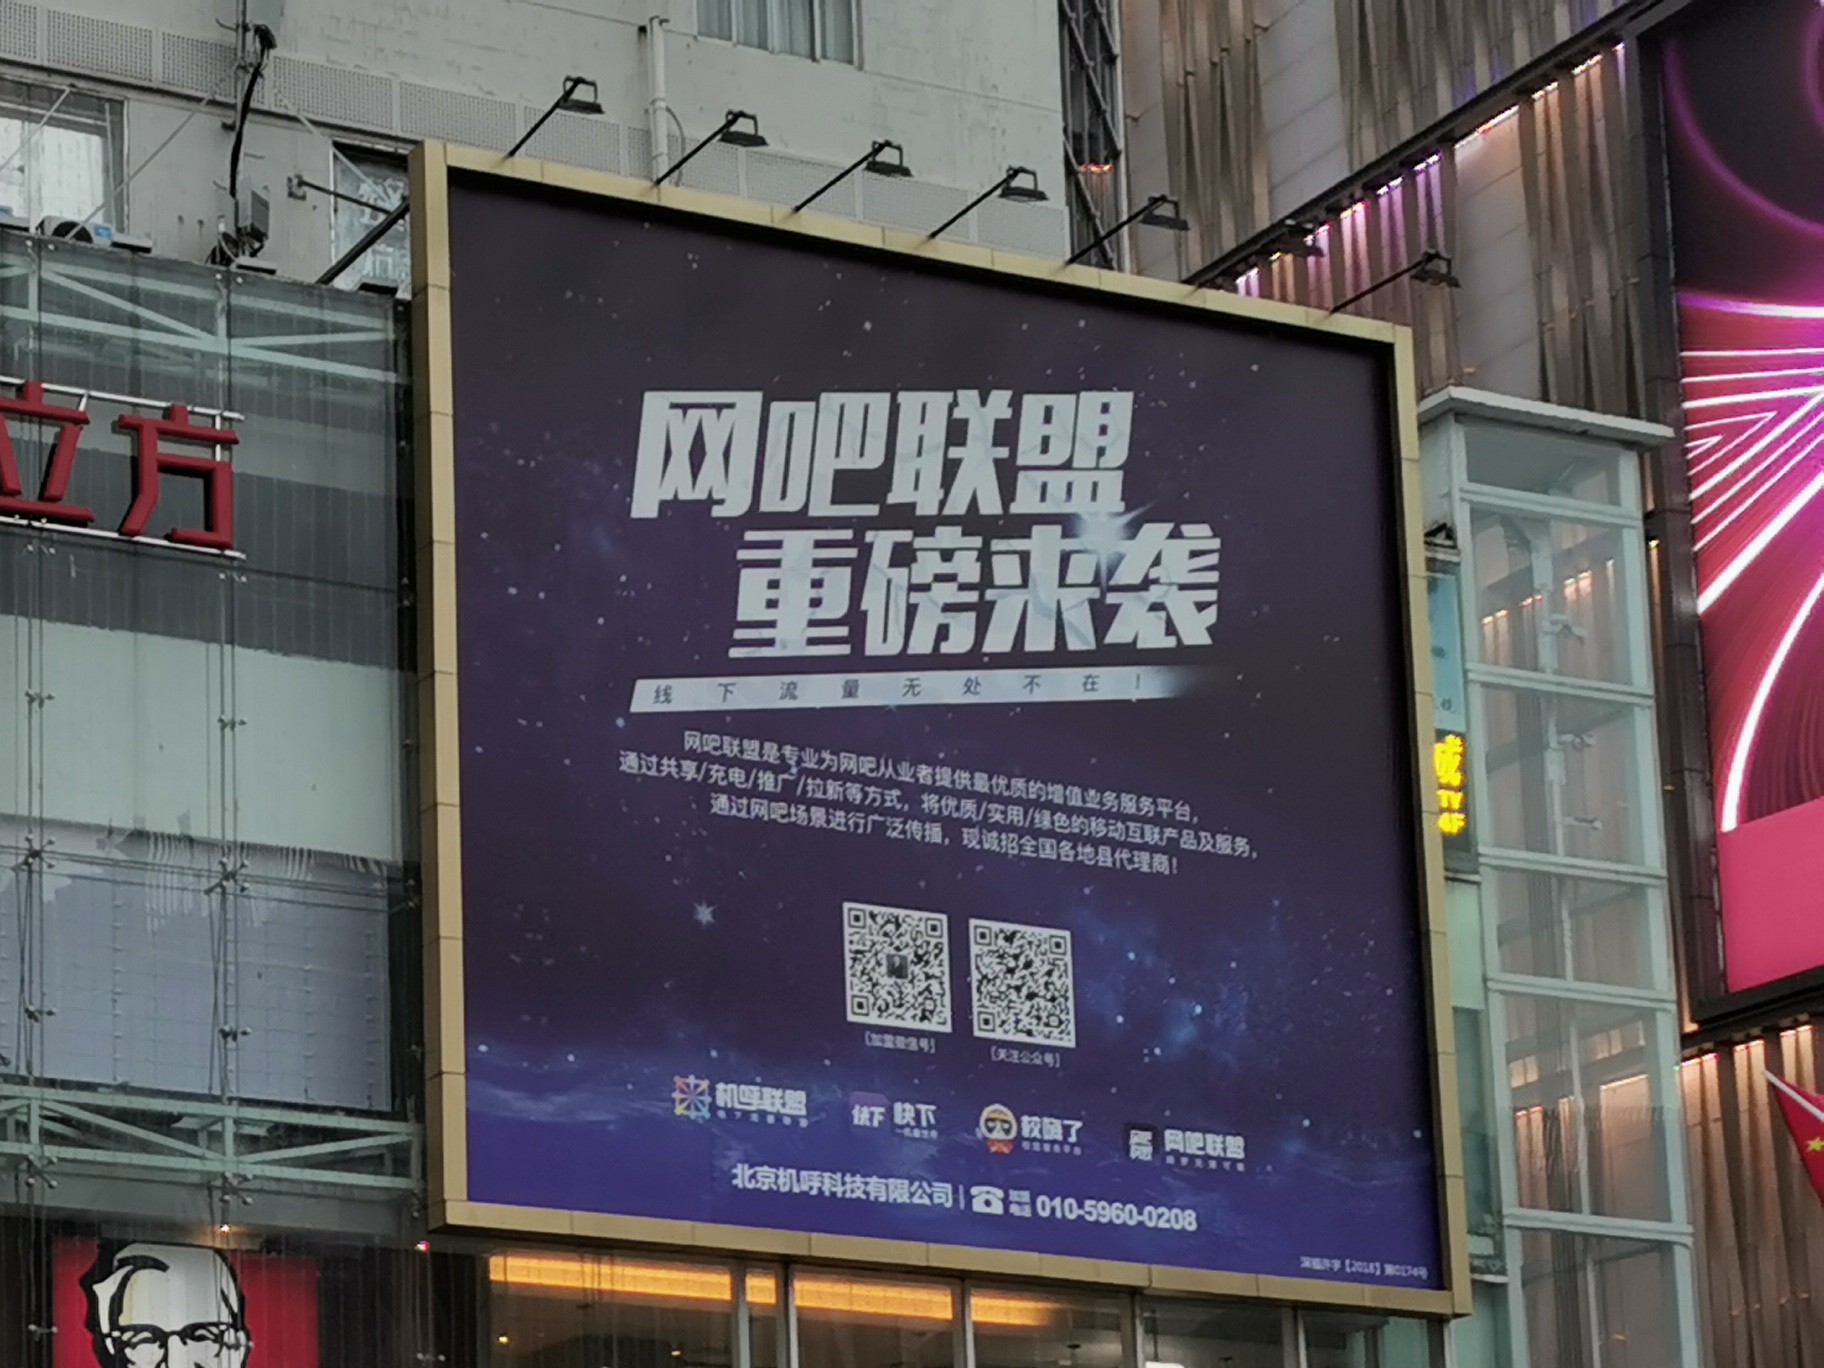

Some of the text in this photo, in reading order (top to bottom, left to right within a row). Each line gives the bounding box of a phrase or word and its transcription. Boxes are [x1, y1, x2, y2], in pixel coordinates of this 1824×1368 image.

[631, 390, 1134, 518] 网吧联盟
[728, 522, 1222, 658] 重磅来袭
[1035, 1194, 1198, 1232] 010-5960-0208
